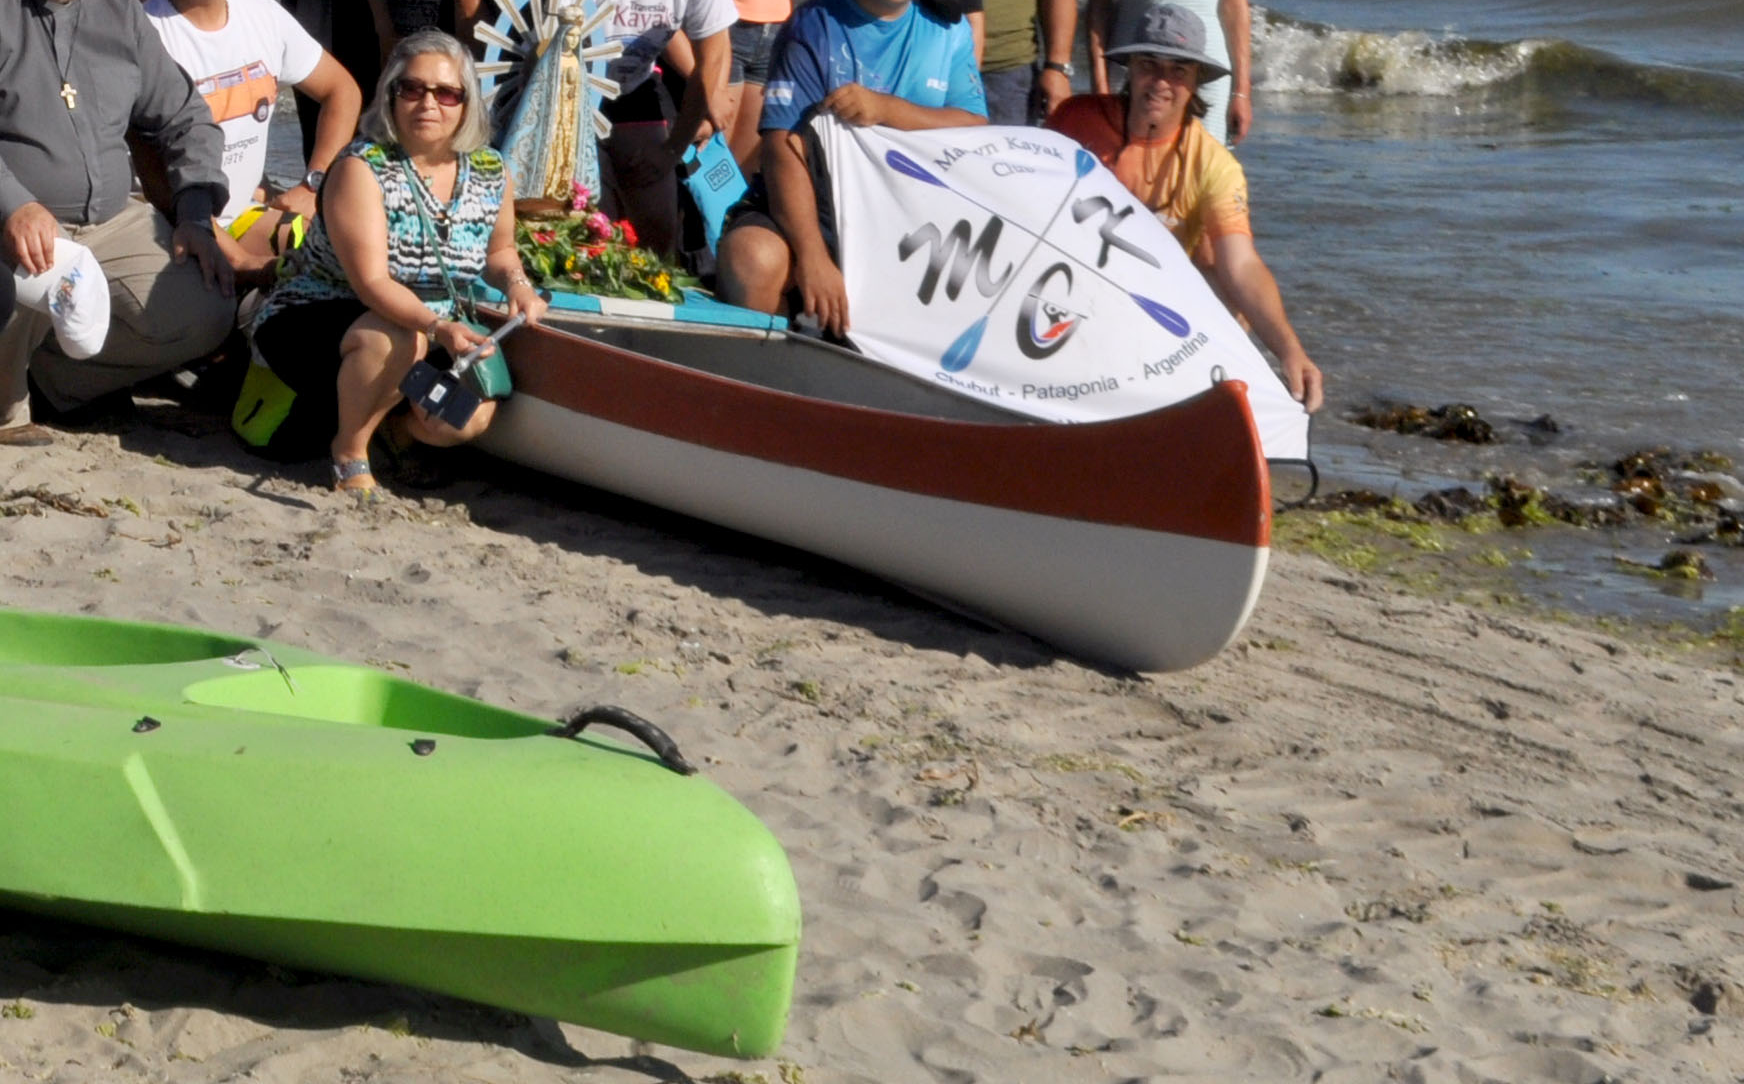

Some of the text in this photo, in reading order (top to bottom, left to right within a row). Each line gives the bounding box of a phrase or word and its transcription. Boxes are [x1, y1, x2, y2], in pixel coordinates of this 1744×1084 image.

[933, 136, 1064, 172] Mayn Kayak
[1021, 377, 1120, 402] Patagonia
[1142, 330, 1210, 380] Argentina
